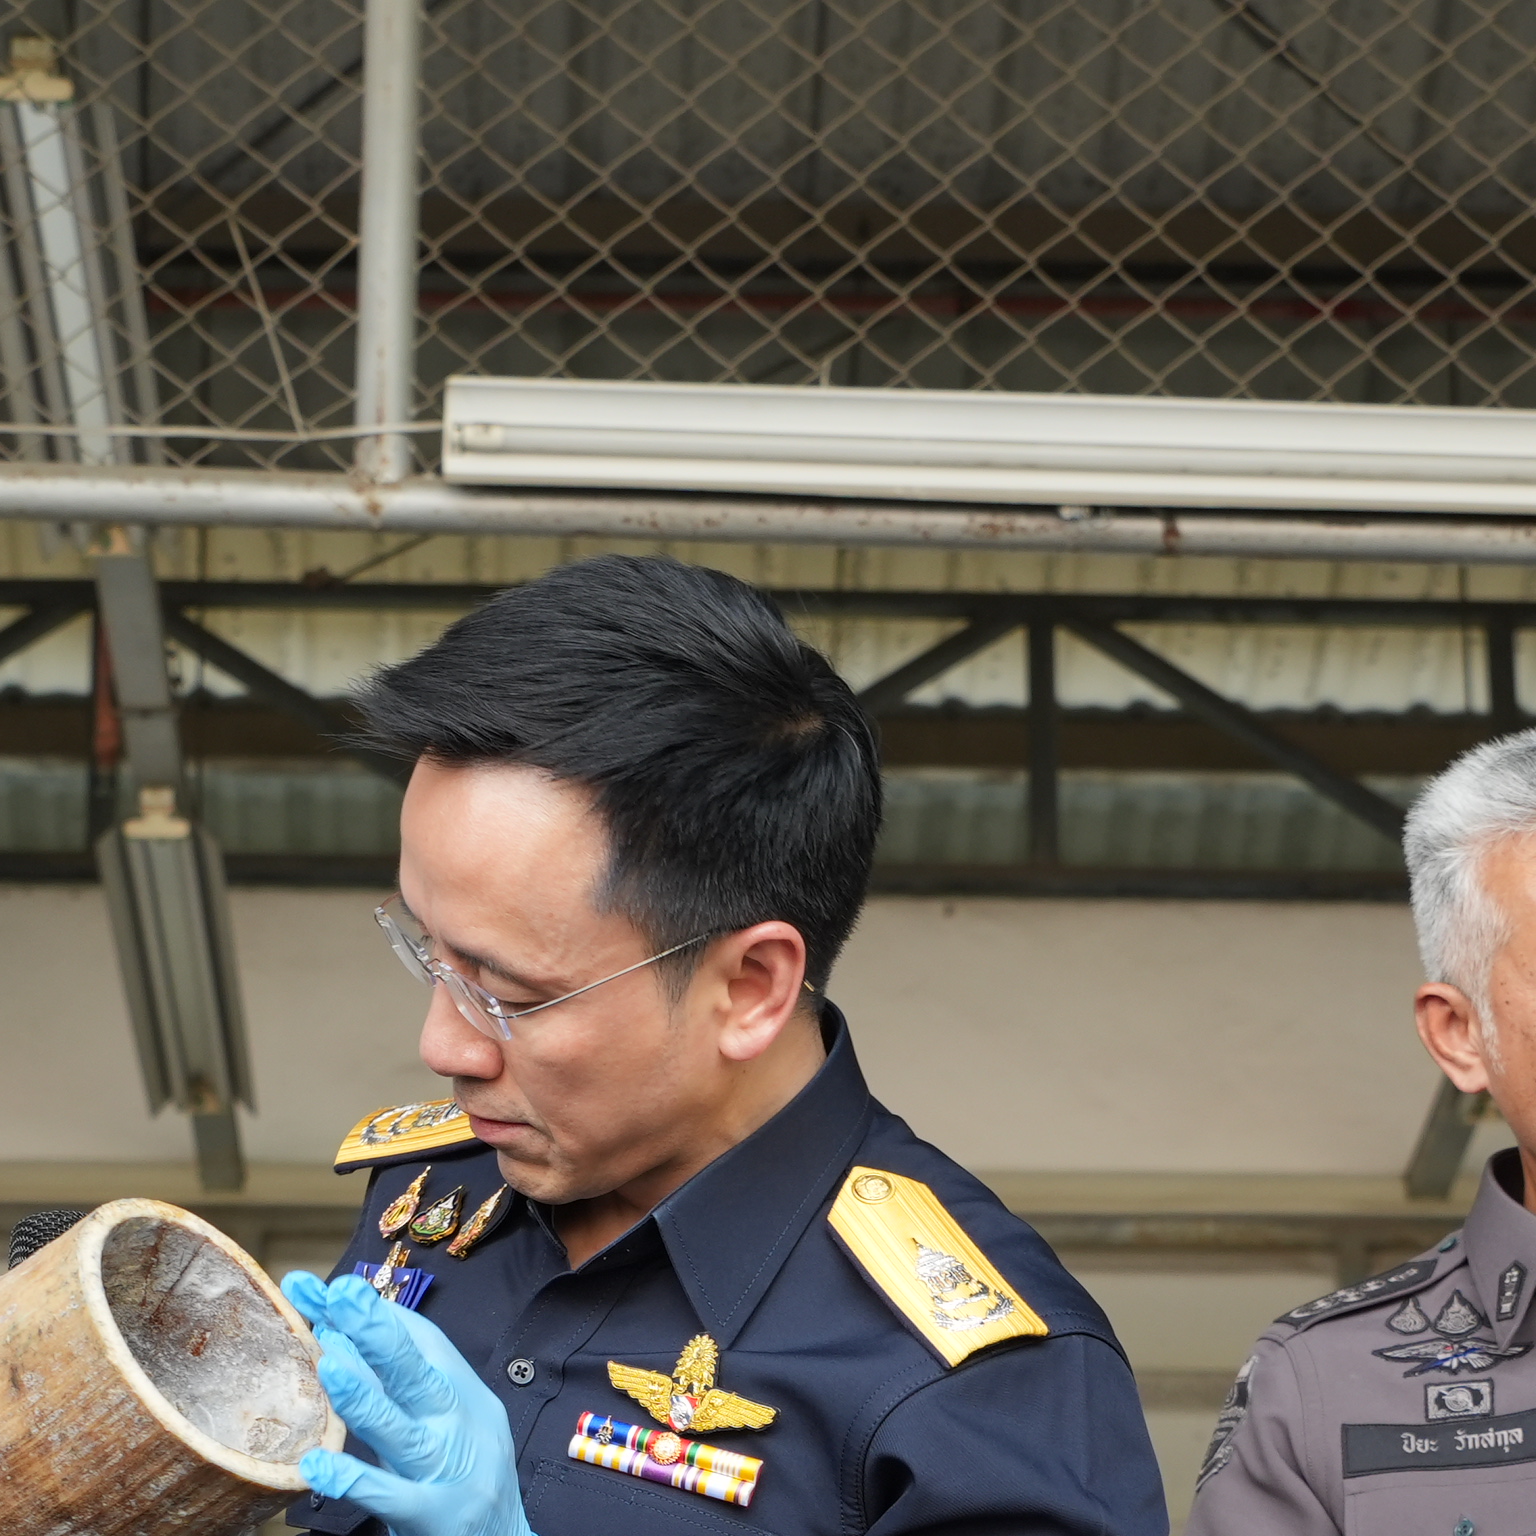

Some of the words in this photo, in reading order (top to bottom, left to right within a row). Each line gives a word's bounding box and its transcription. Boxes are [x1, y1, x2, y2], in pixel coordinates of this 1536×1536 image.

[1400, 1432, 1439, 1454] ปิยะ
[1454, 1427, 1524, 1454] รักสกุล
